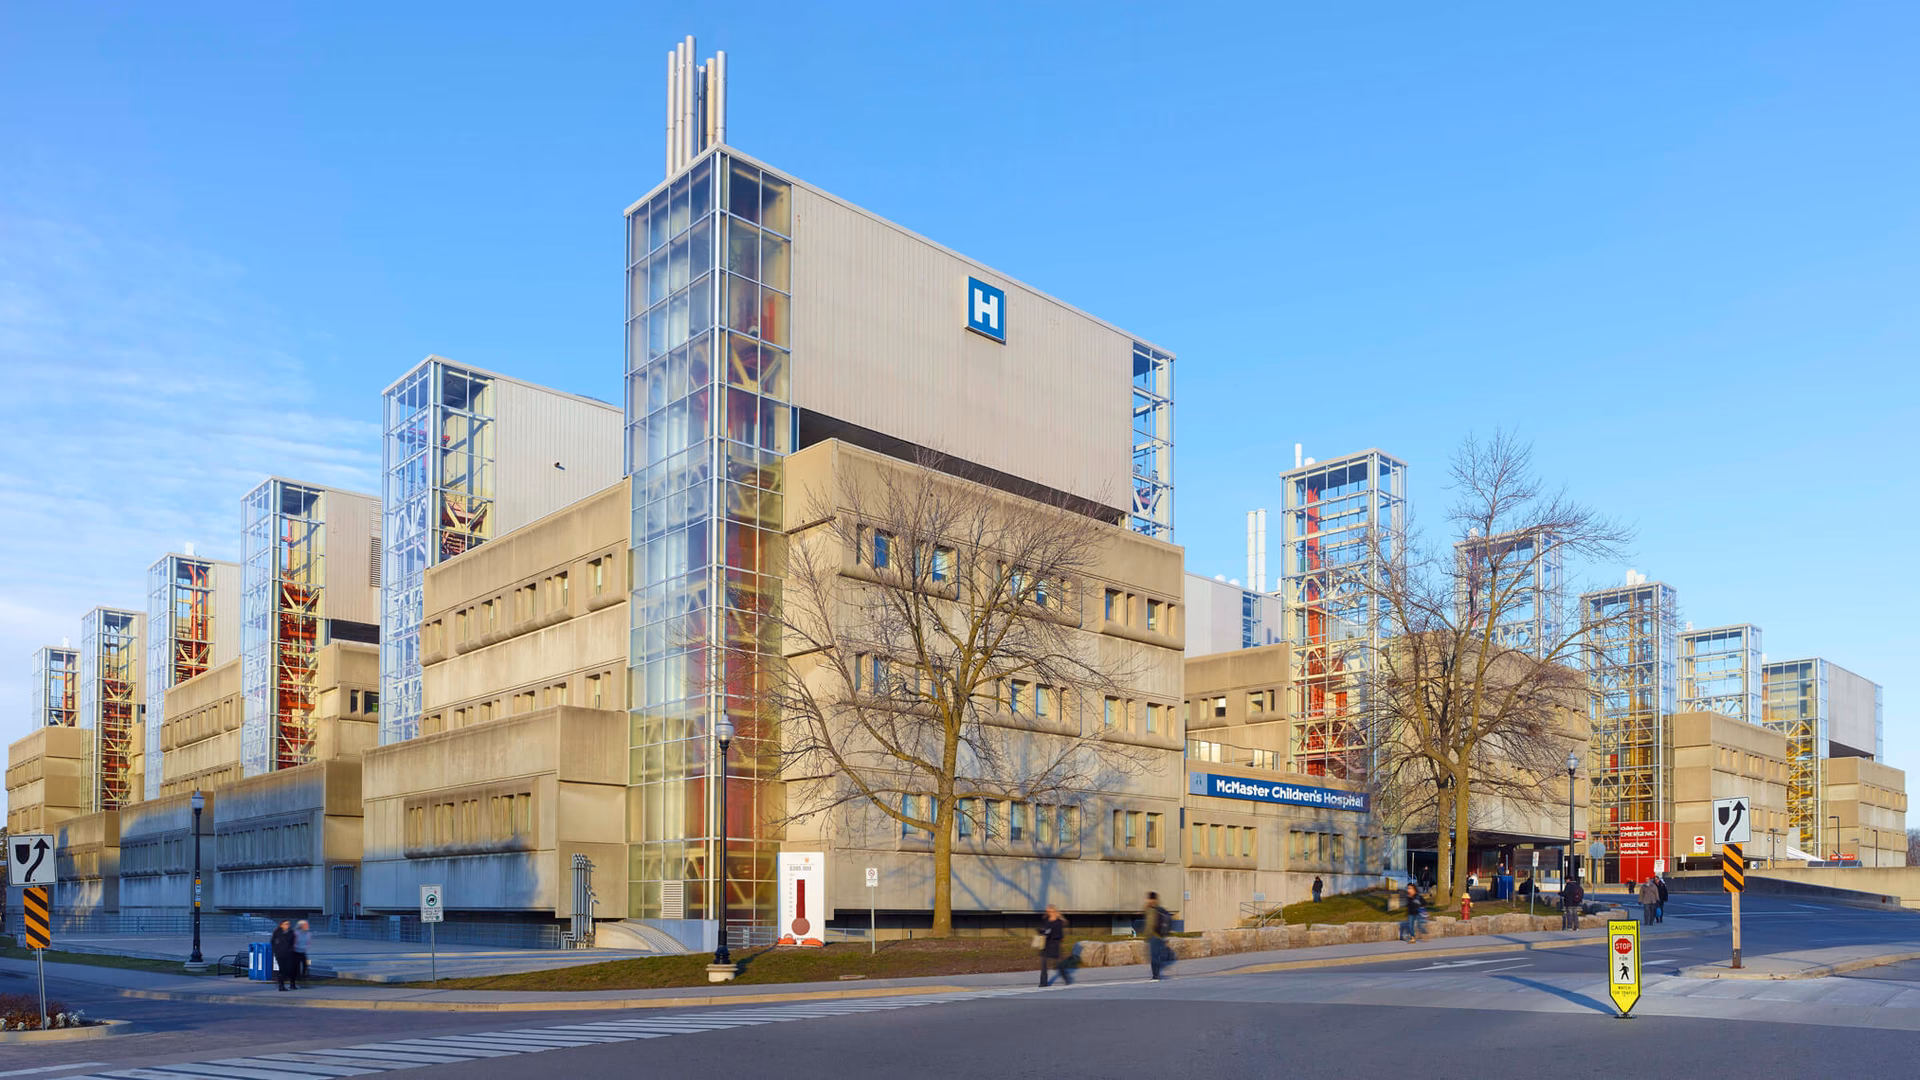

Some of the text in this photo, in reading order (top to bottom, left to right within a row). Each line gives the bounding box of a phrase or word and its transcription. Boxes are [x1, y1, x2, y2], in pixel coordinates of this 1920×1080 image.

[974, 287, 998, 330] H
[1216, 779, 1364, 808] McMaster Children's Hospital
[1615, 942, 1631, 950] STOP
